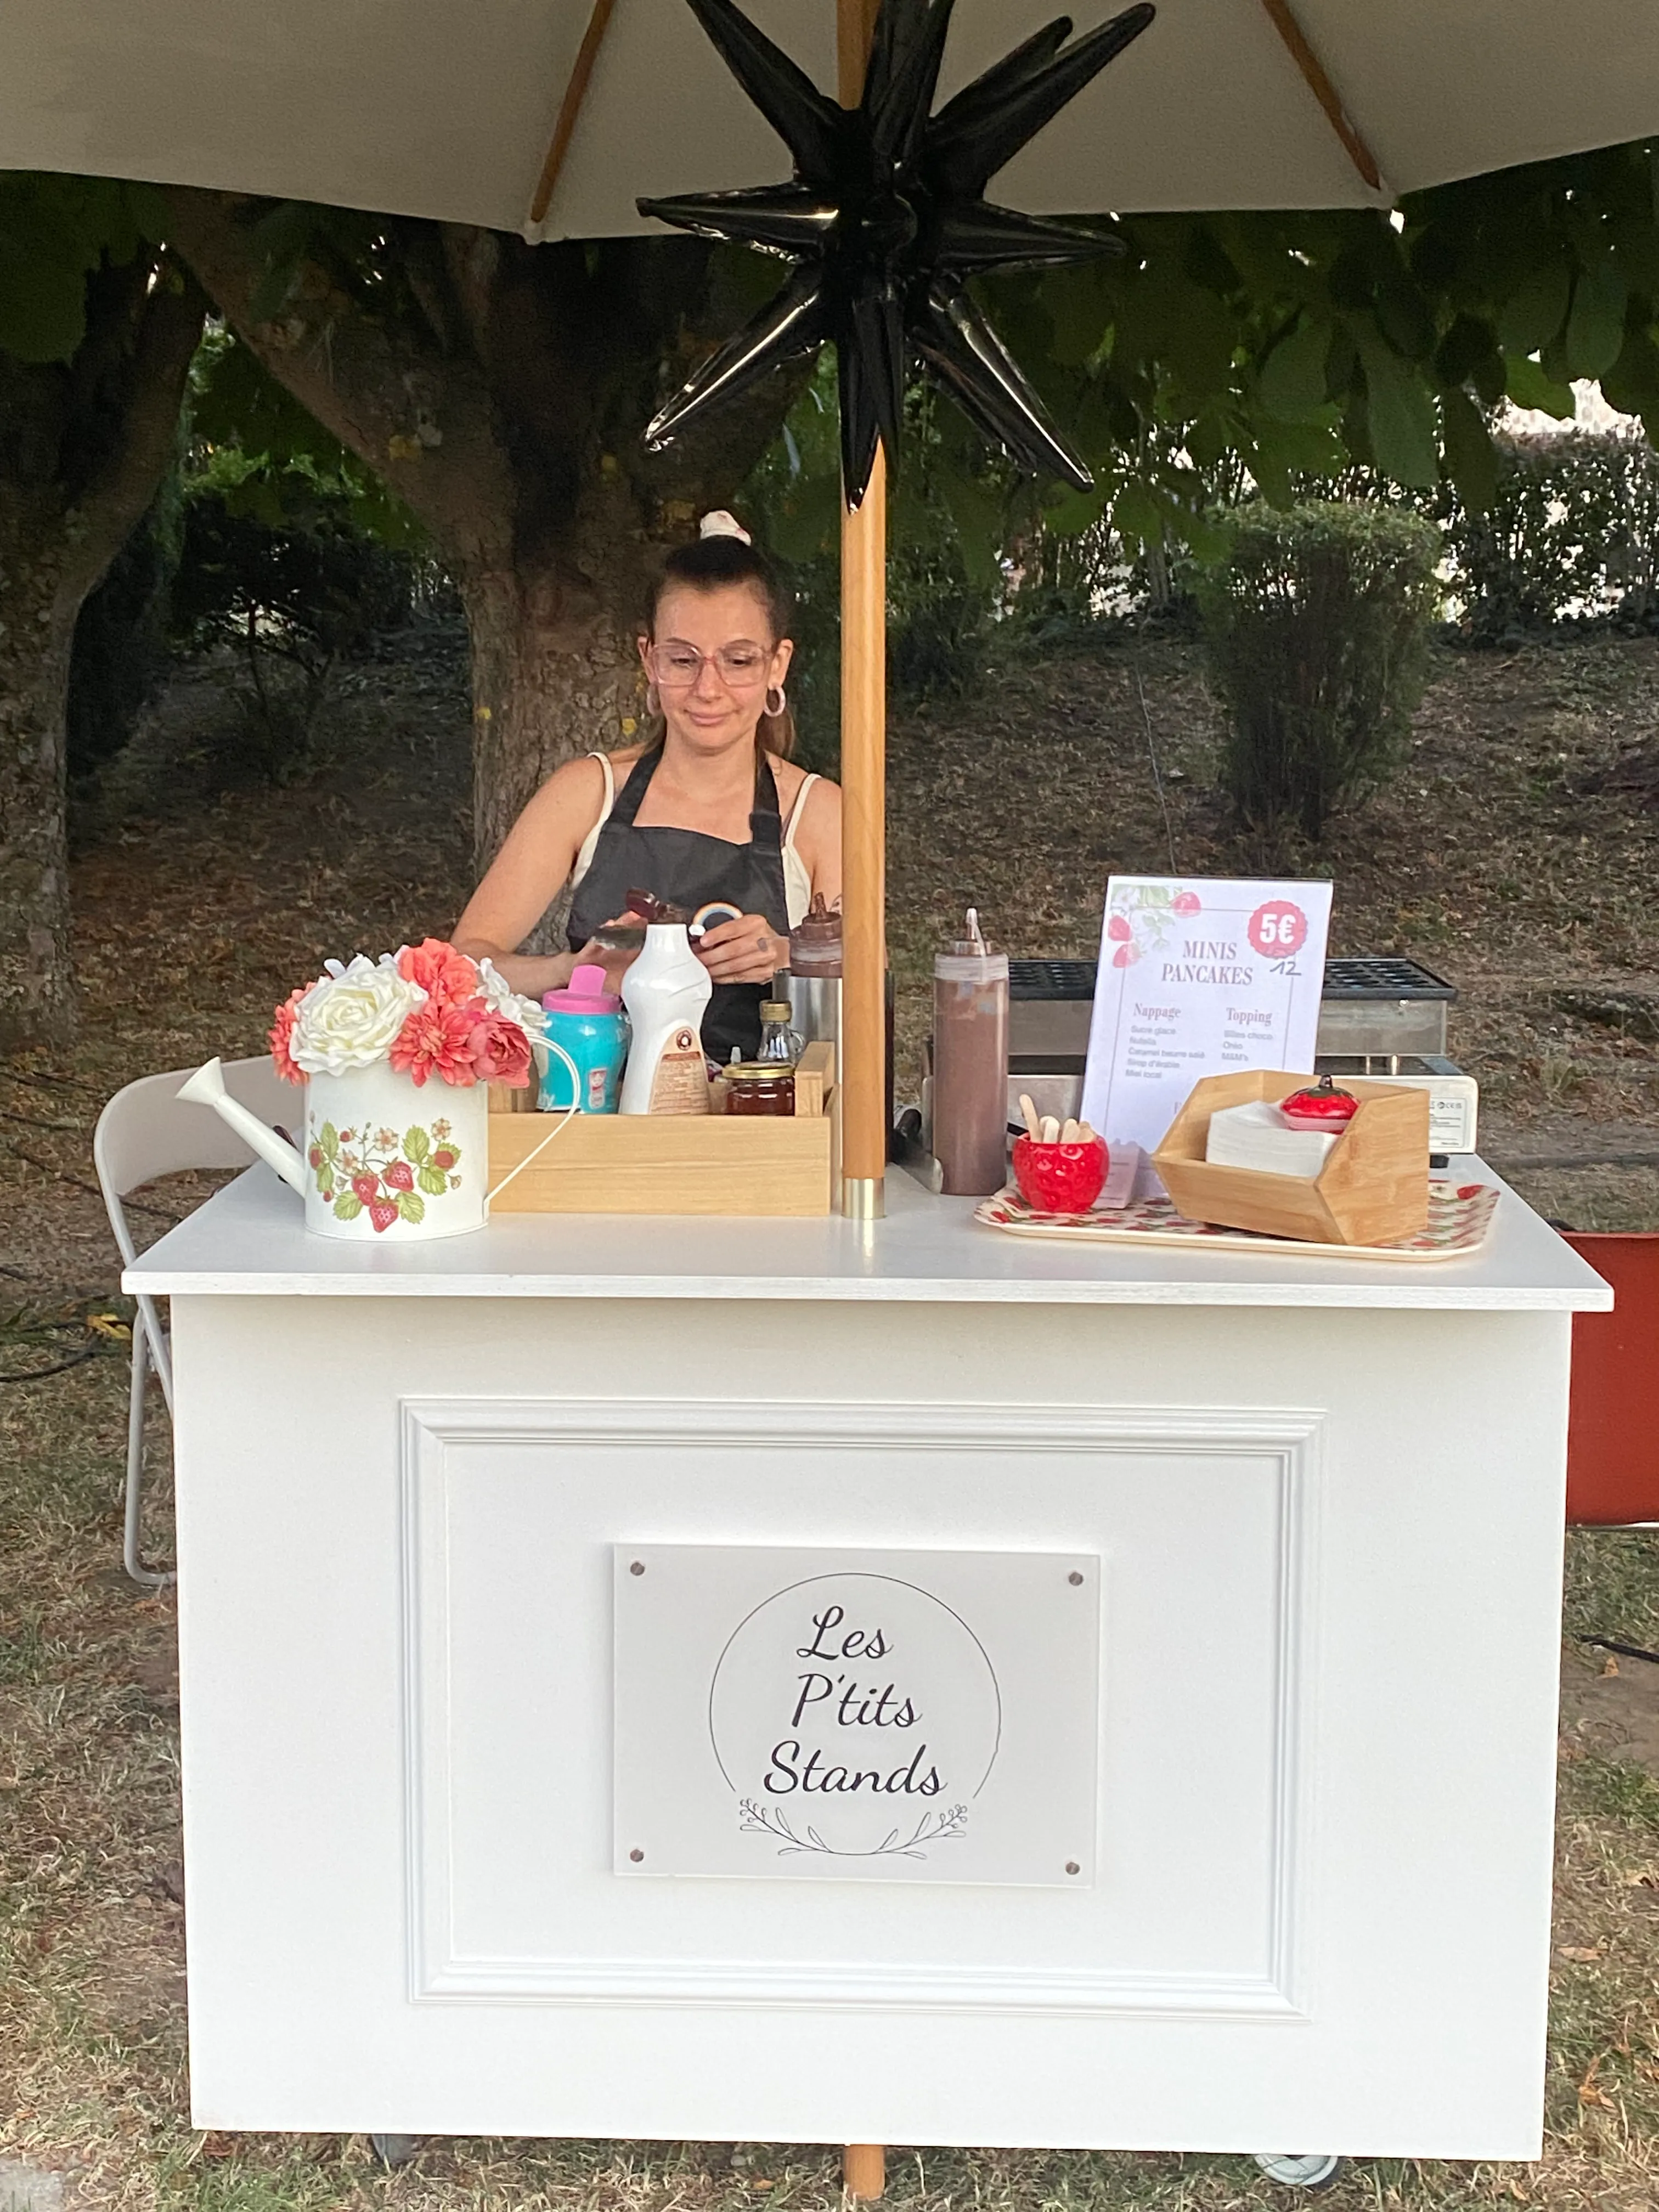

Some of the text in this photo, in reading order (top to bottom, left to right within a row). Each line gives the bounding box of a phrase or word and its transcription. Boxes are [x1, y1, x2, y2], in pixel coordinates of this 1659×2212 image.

[1260, 913, 1296, 944] 5€
[1183, 940, 1238, 961] MINIS
[1161, 963, 1254, 986] PANCAKES
[1133, 1002, 1182, 1021] Nappage
[1226, 1007, 1273, 1026] Topping
[797, 1606, 894, 1660] Les
[792, 1673, 923, 1728] P'tits
[764, 1740, 949, 1796] Stands
